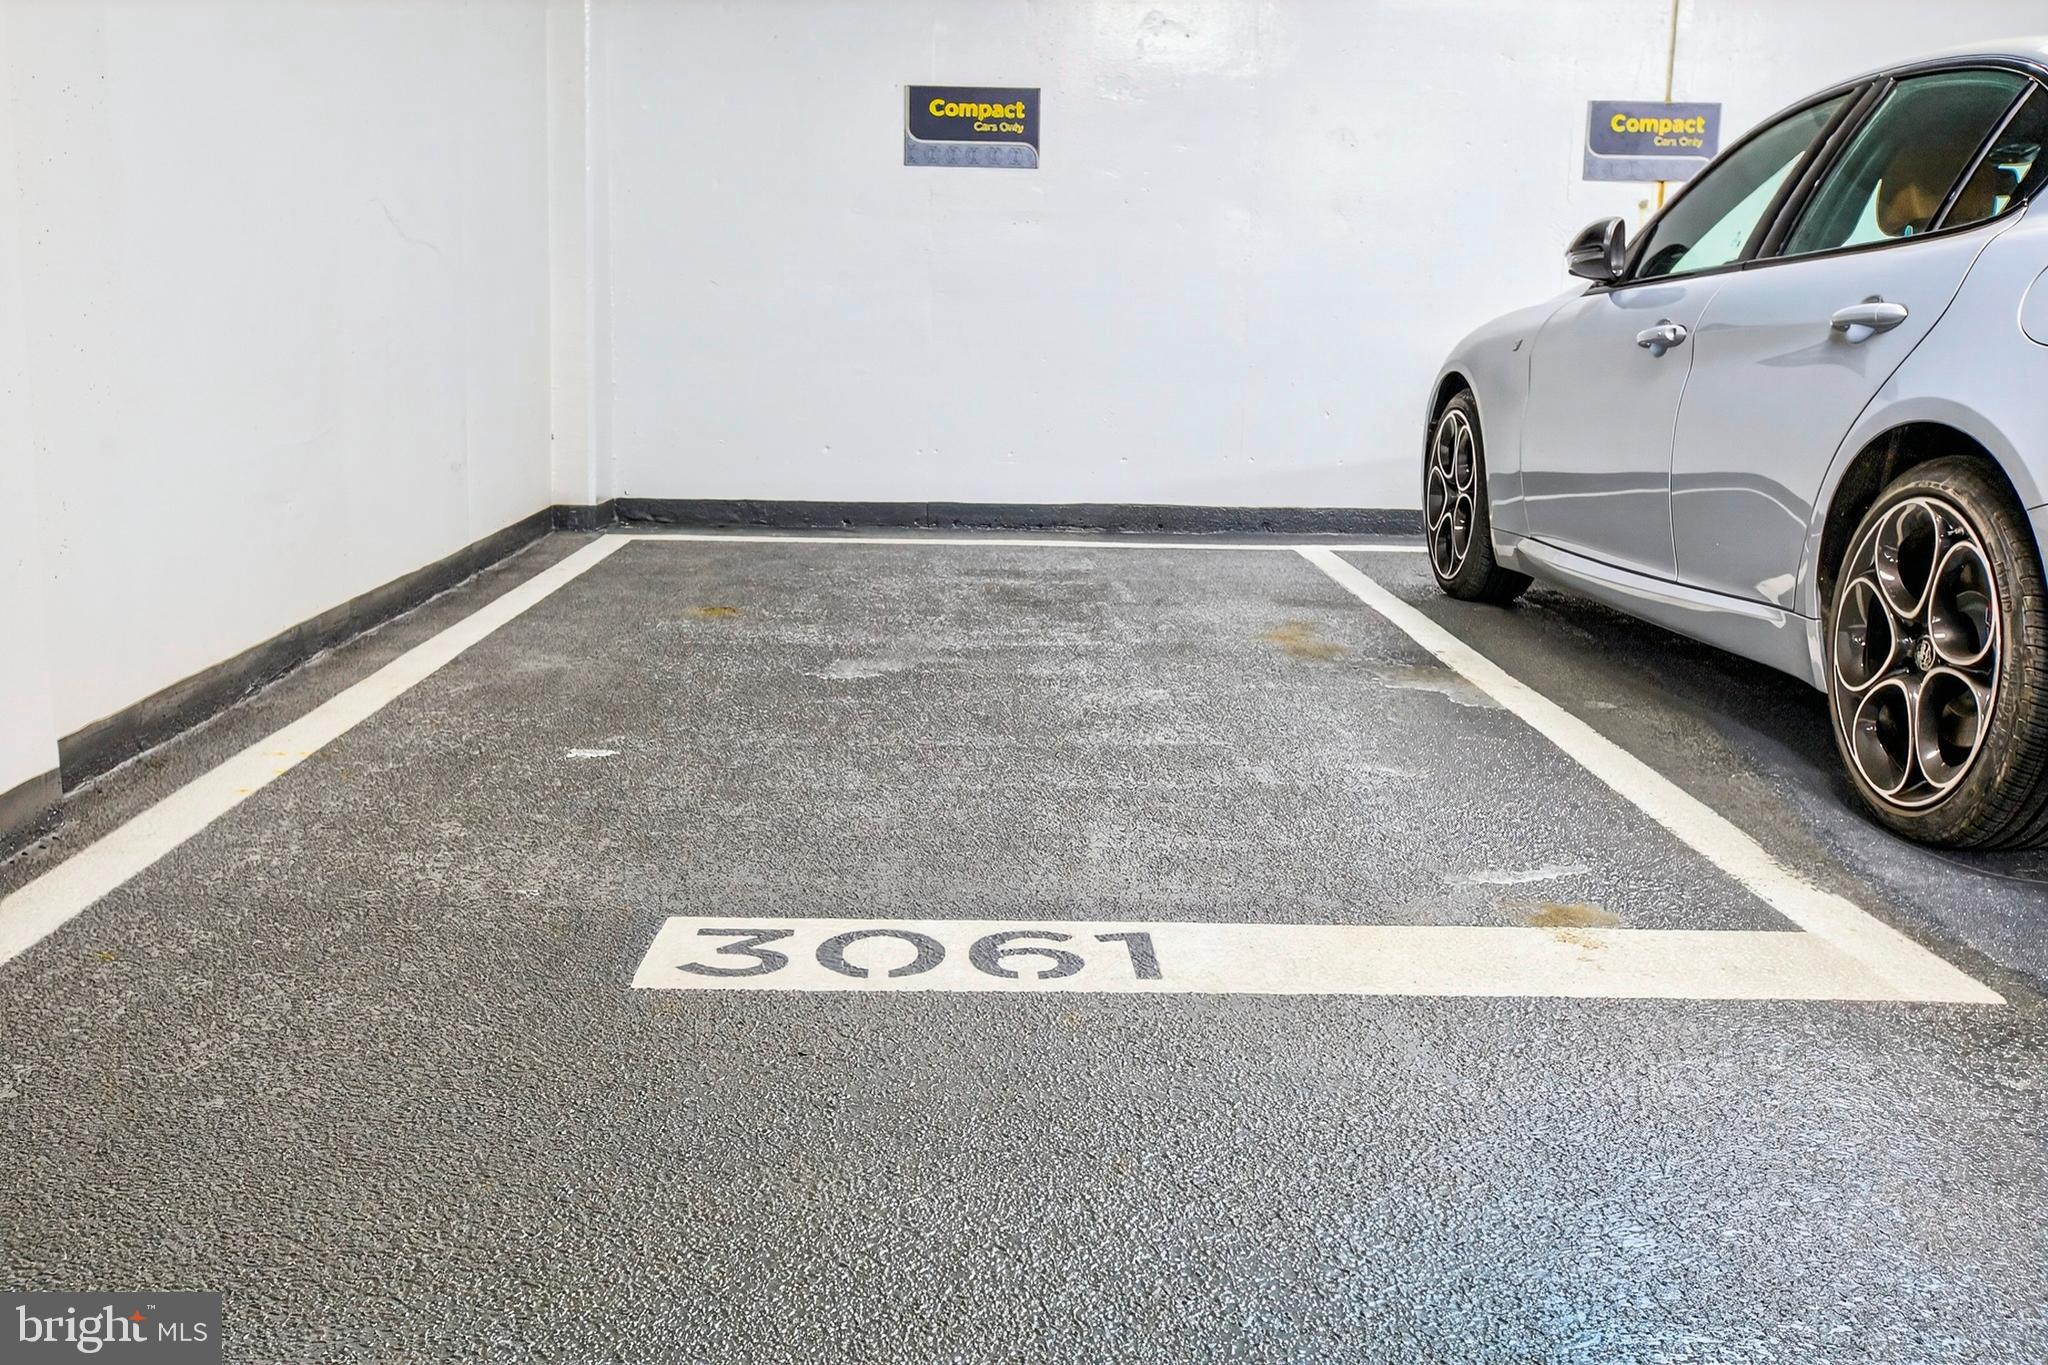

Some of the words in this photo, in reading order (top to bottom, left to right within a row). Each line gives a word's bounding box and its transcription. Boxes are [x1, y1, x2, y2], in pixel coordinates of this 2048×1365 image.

[929, 99, 1025, 121] Compact
[973, 121, 998, 132] Cars
[999, 122, 1024, 134] Only
[1610, 114, 1706, 136] Compact
[1654, 137, 1678, 147] Cars
[1679, 137, 1703, 148] Only
[675, 928, 1163, 981] 3061
